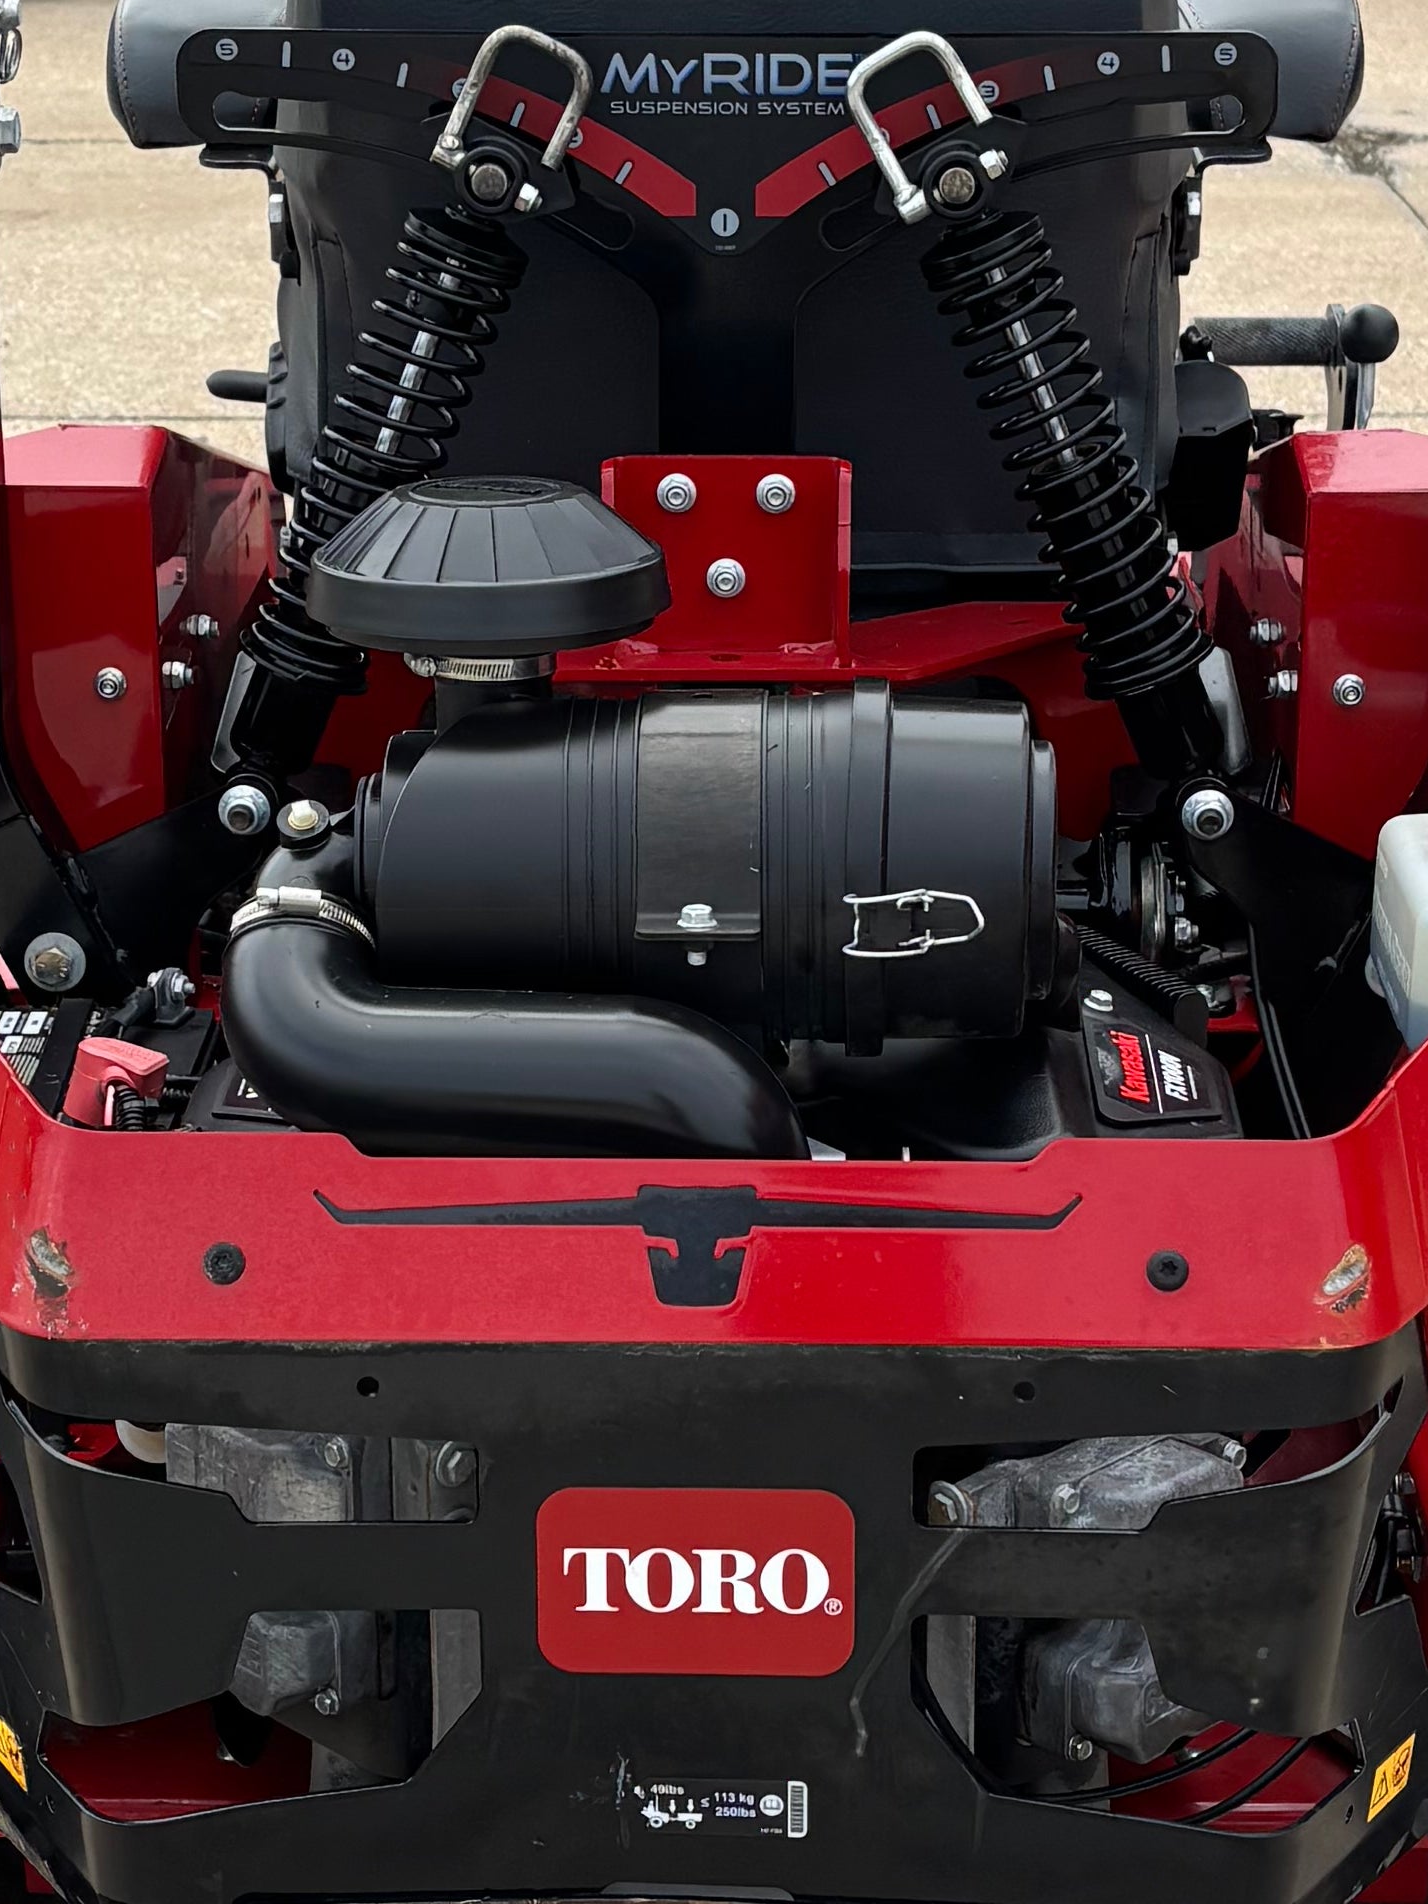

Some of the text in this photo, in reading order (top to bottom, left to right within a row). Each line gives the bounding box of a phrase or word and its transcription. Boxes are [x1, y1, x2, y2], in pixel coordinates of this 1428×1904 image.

[610, 100, 845, 116] SUSPENSION SYSTEM
[1109, 1029, 1150, 1104] Kawasaki
[714, 1792, 736, 1803] 113
[739, 1793, 755, 1806] kg
[715, 1806, 757, 1818] 250lbs
